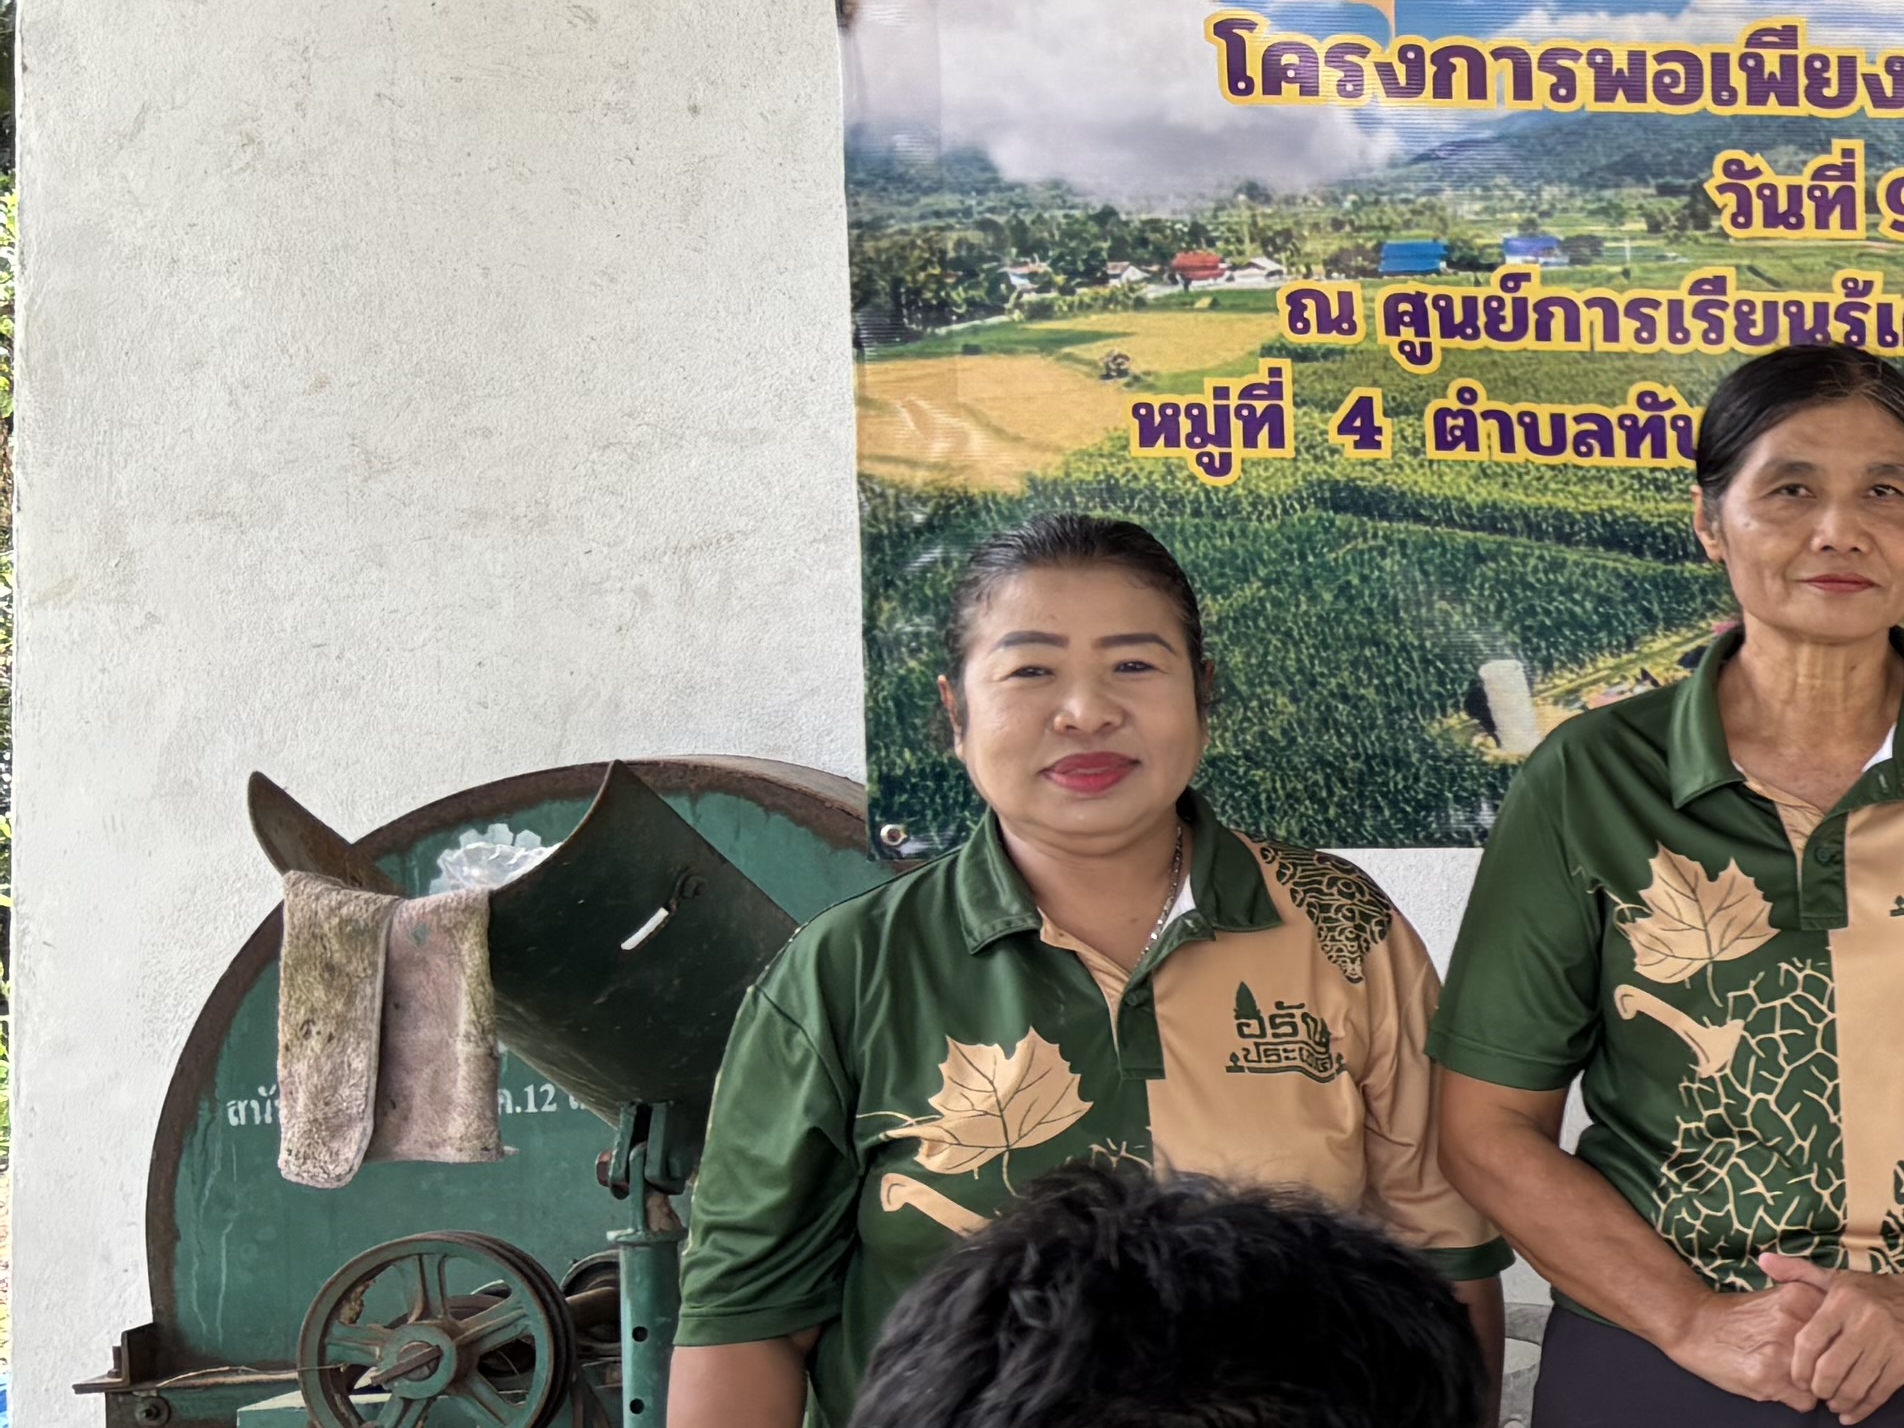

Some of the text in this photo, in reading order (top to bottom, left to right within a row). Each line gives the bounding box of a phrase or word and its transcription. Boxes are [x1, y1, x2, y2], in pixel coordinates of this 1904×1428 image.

[1718, 148, 1857, 231] วันที่
[1285, 286, 1359, 337] ณ
[1131, 367, 1288, 478] หมู่ที่
[1336, 390, 1386, 452] 4
[1433, 387, 1698, 462] ตำบลทับ
